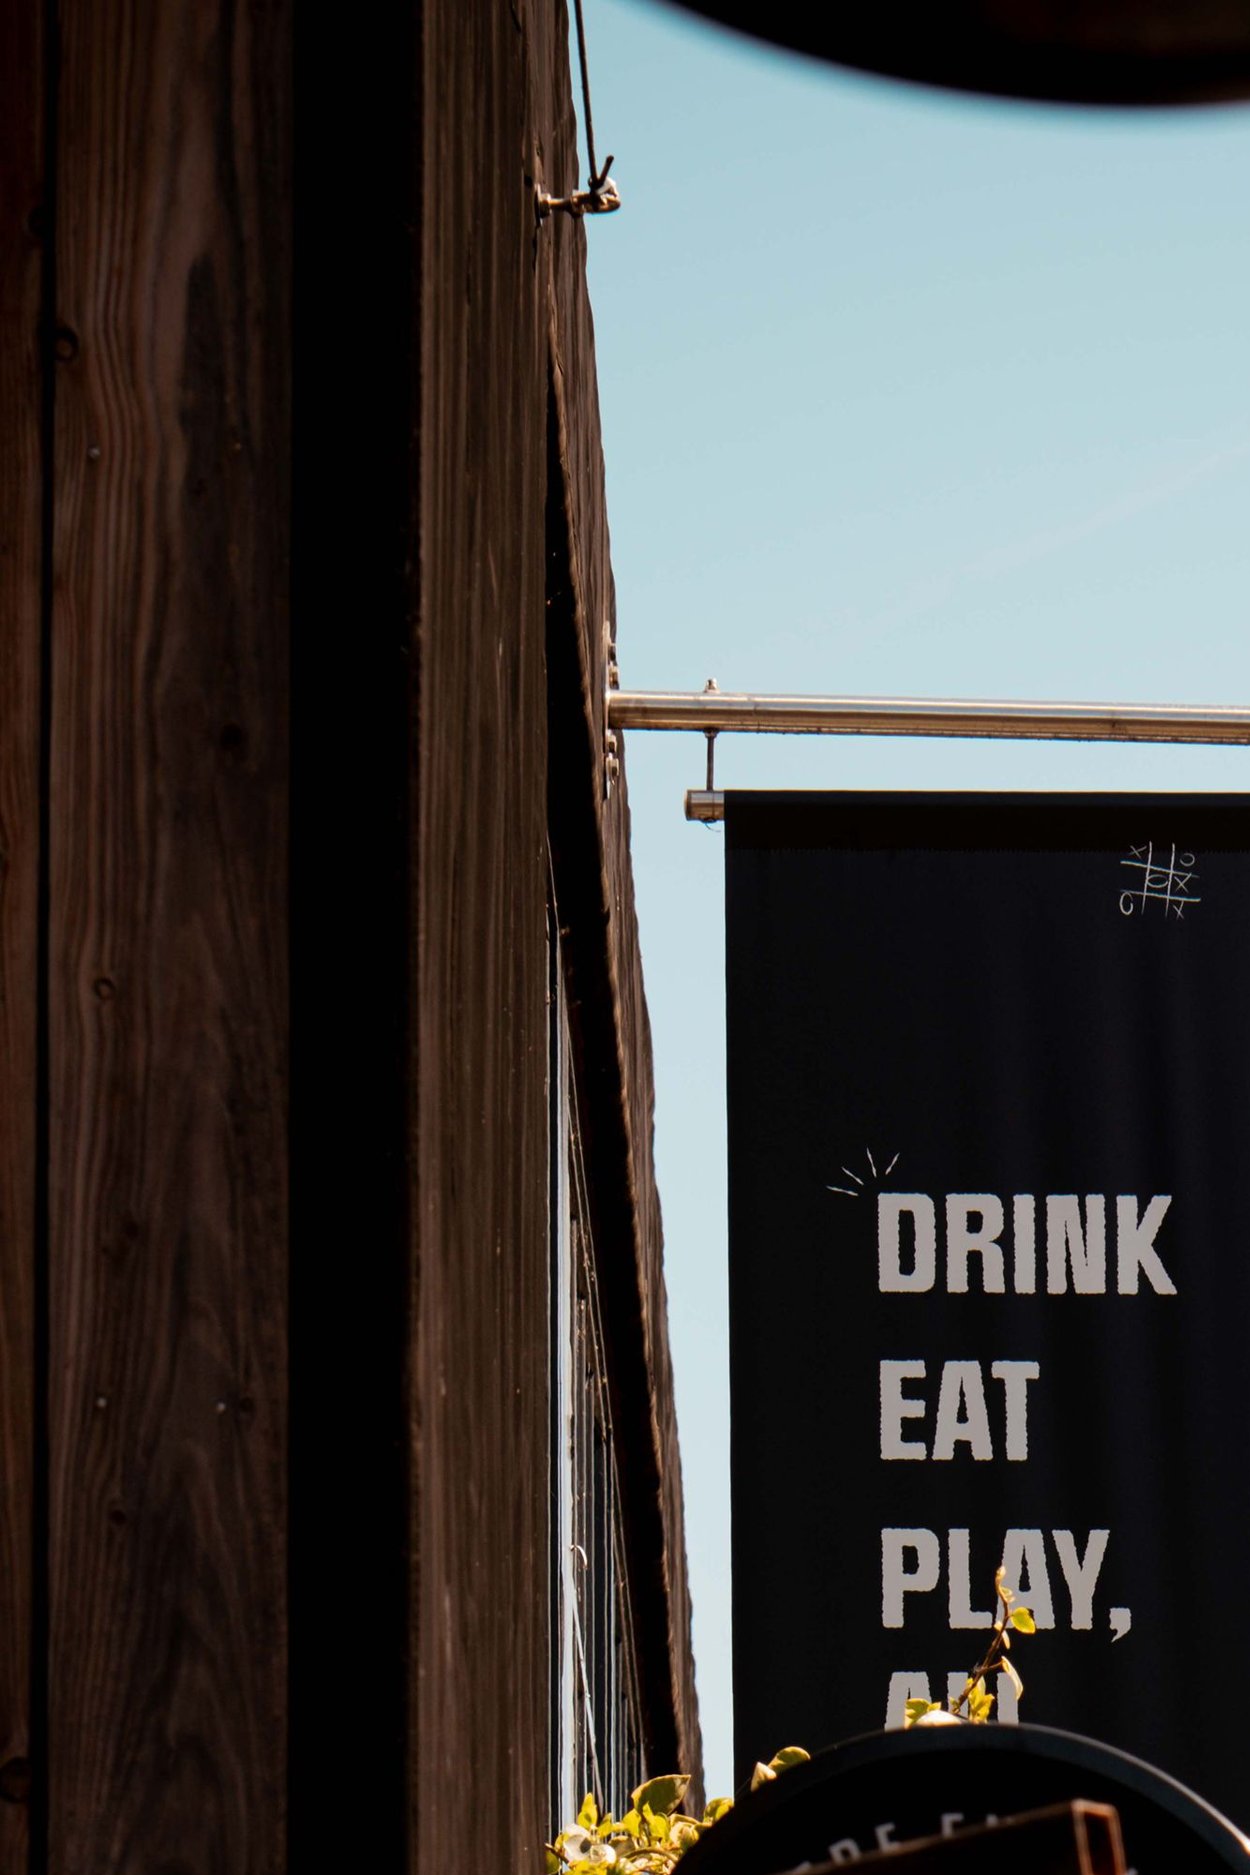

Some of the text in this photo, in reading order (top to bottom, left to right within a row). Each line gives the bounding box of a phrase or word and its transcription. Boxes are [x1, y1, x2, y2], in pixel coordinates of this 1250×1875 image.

[877, 1192, 1178, 1295] DRINK
[879, 1359, 1041, 1462] EAT
[880, 1527, 1132, 1643] PLAY,
